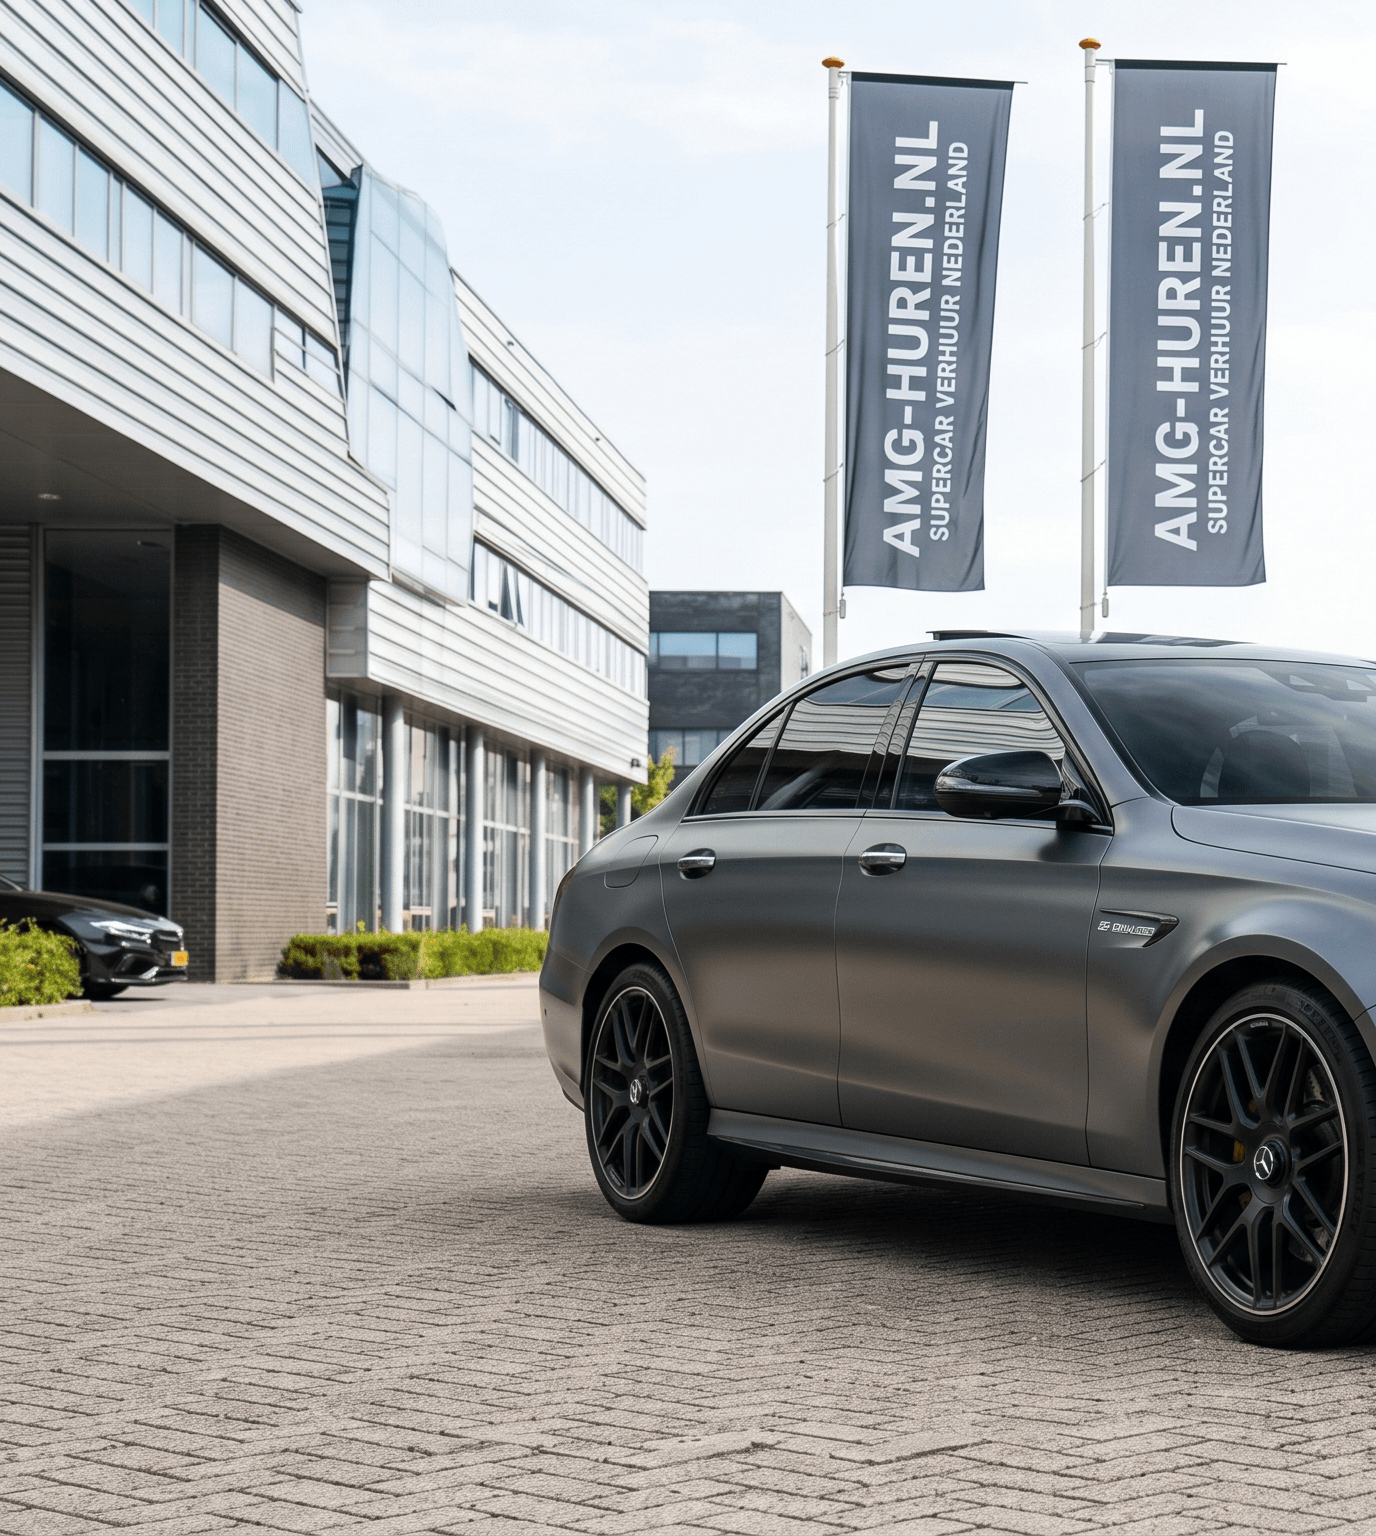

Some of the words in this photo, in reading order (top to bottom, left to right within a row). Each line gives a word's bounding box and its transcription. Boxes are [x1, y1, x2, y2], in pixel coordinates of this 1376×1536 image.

[941, 141, 969, 287] NEDERLAND
[1211, 130, 1235, 277] NEDERLAND
[883, 120, 939, 558] AMG-HUREN.NL
[936, 294, 961, 409] VERHUUR
[1154, 108, 1205, 552] AMG-HUREN.NL
[1209, 284, 1232, 401] VERHUUR
[929, 415, 955, 542] SUPERCAR
[1207, 407, 1230, 535] SUPERCAR
